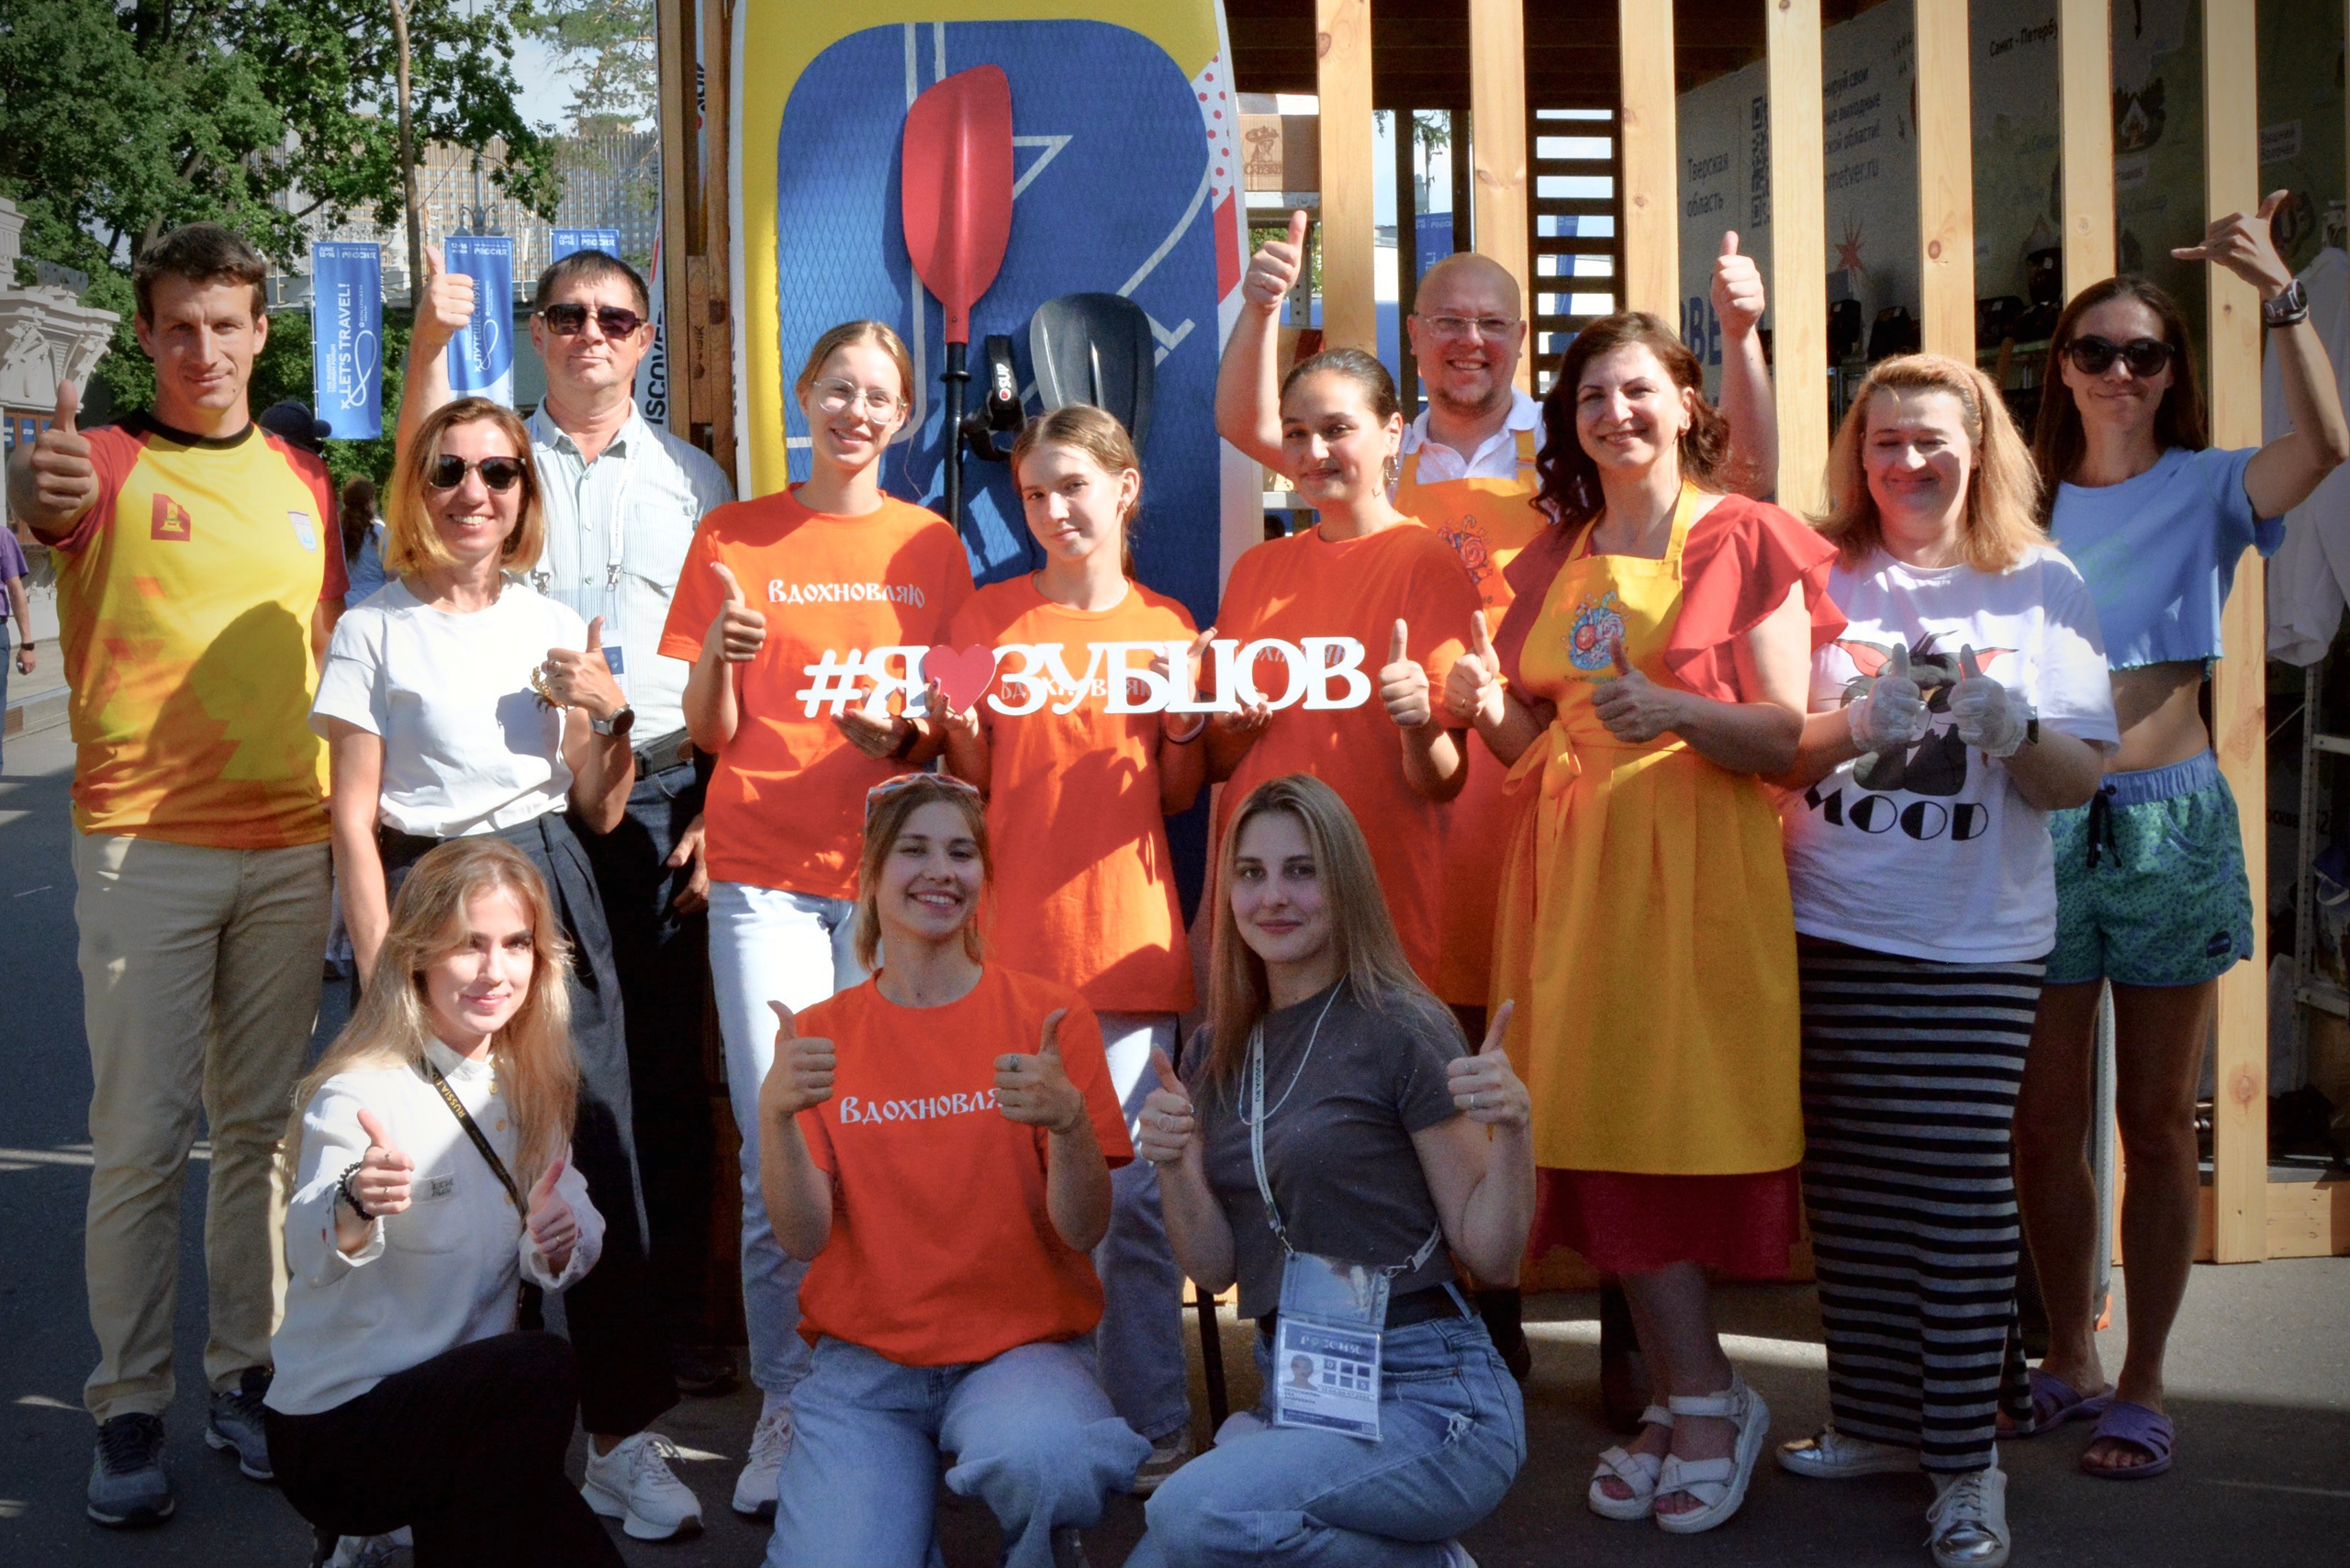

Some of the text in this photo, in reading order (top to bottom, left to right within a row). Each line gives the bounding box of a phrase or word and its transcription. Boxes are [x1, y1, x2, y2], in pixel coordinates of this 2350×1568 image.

[1849, 67, 1869, 88] свои
[1686, 151, 1729, 185] Тверская
[1686, 190, 1724, 218] область
[338, 283, 352, 395] LET'S TRAVEL!
[995, 363, 1013, 389] SUP
[987, 636, 1371, 718] ЗУБЦОВ
[1254, 1058, 1262, 1103] RUSSIA.RU
